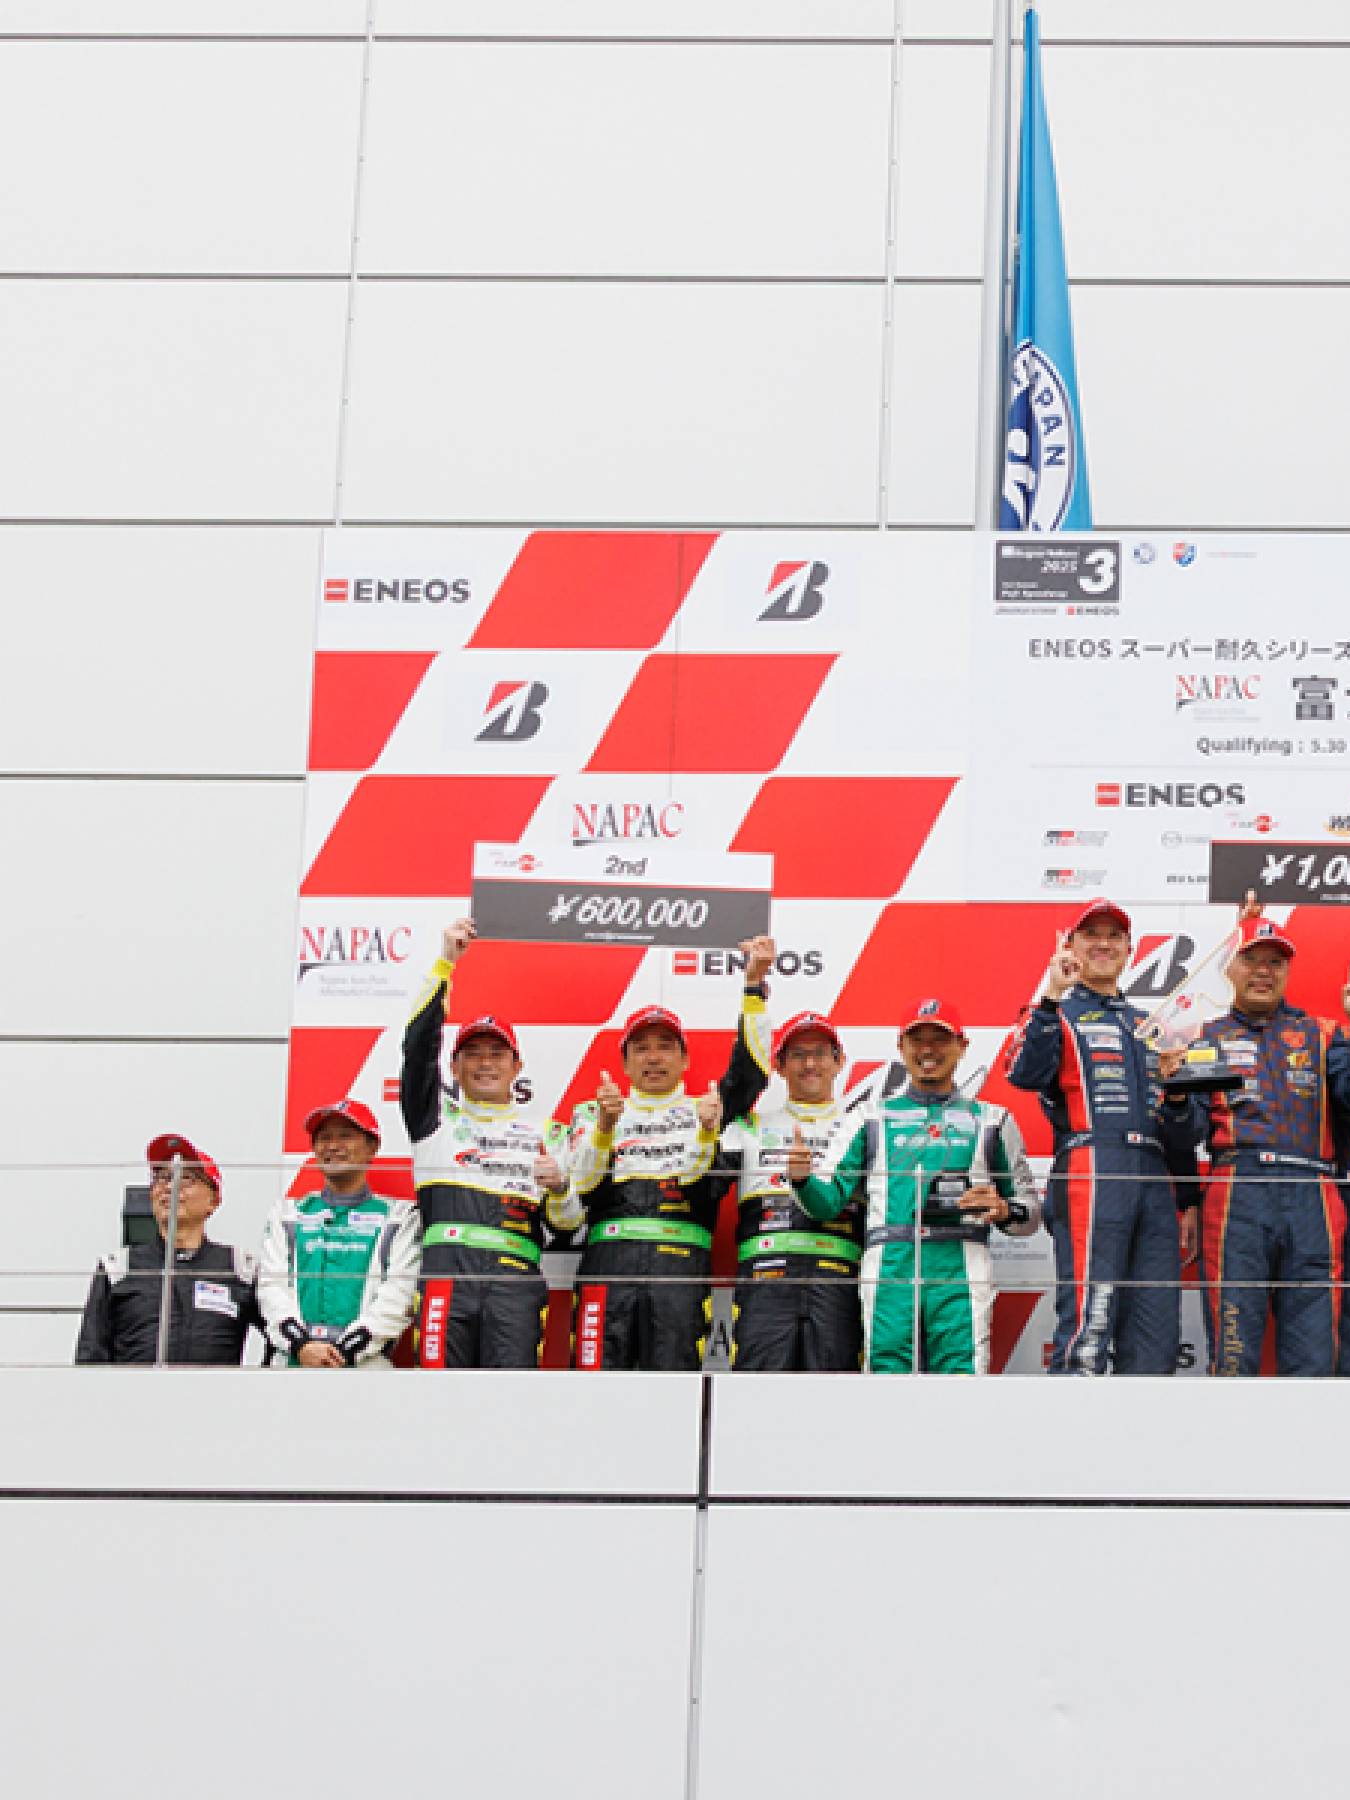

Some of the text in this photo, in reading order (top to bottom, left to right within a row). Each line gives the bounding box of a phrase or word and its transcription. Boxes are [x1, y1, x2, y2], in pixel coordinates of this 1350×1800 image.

[1077, 549, 1117, 594] 3
[353, 578, 471, 604] ENEOS
[1028, 638, 1113, 659] ENEOS
[1175, 674, 1262, 700] NAPAC
[1125, 783, 1246, 808] ENEOS
[571, 802, 684, 839] NAPAC
[604, 854, 648, 877] 2nd
[547, 894, 709, 931] ¥600,000
[298, 926, 413, 964] NAPAC
[703, 950, 824, 977] ENOS
